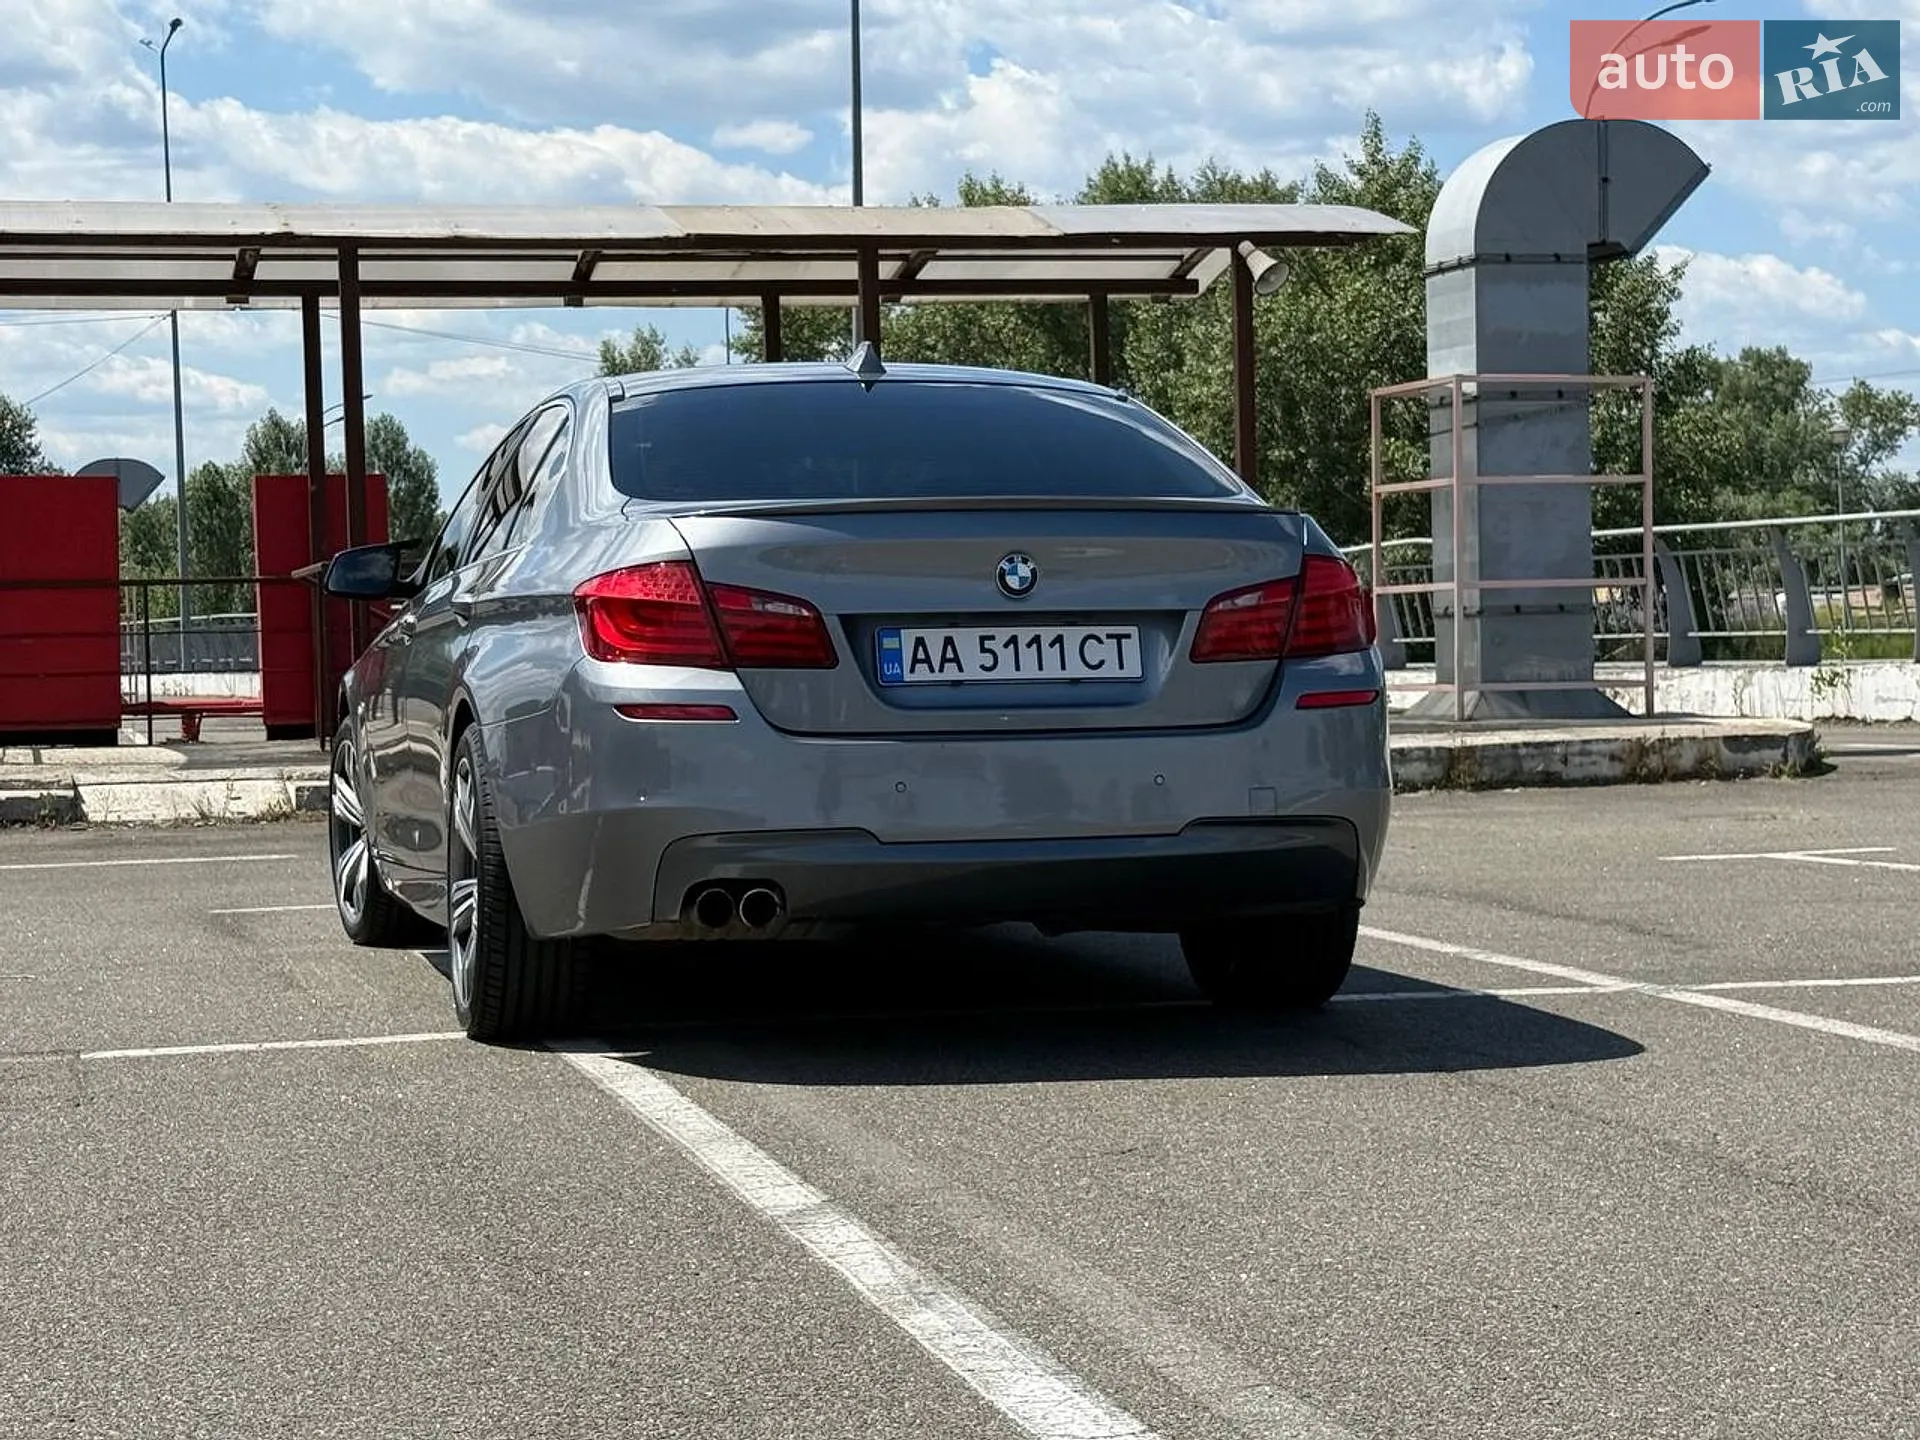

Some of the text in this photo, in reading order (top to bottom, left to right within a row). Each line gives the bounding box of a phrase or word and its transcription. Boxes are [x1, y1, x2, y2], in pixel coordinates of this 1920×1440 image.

[909, 633, 1132, 674] AA 5111 CT
[883, 662, 901, 675] UA
